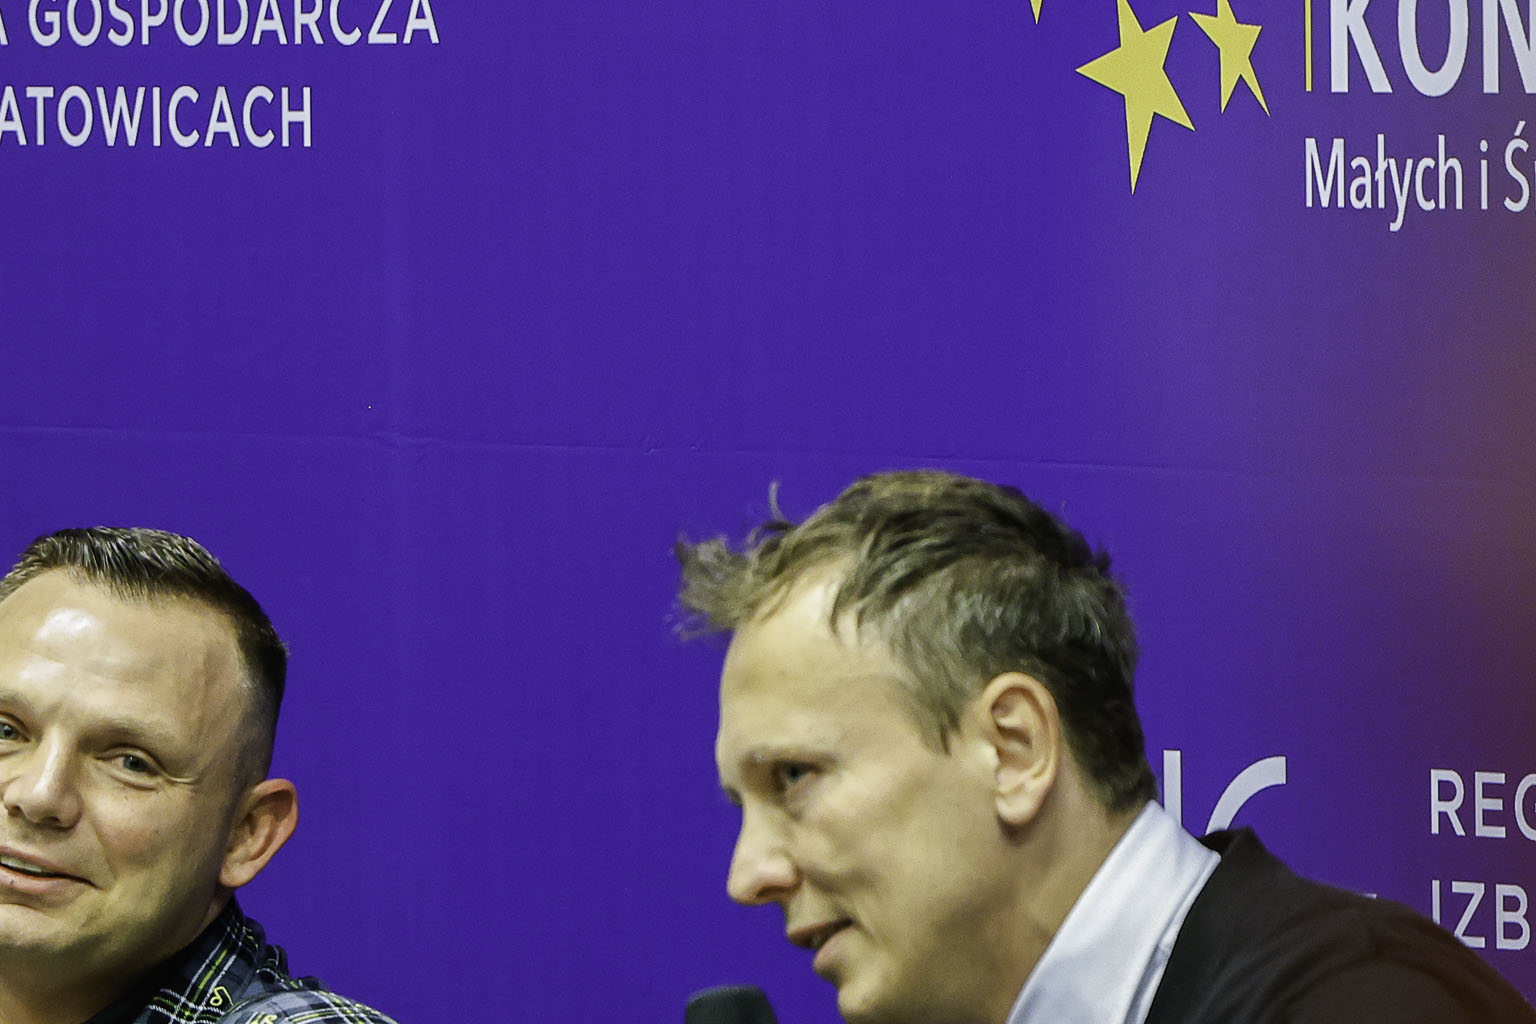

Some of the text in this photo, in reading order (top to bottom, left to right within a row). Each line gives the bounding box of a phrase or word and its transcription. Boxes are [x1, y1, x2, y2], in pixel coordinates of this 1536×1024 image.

[28, 0, 440, 47] GOSPODARCZA
[1305, 120, 1536, 232] Małych i Ś
